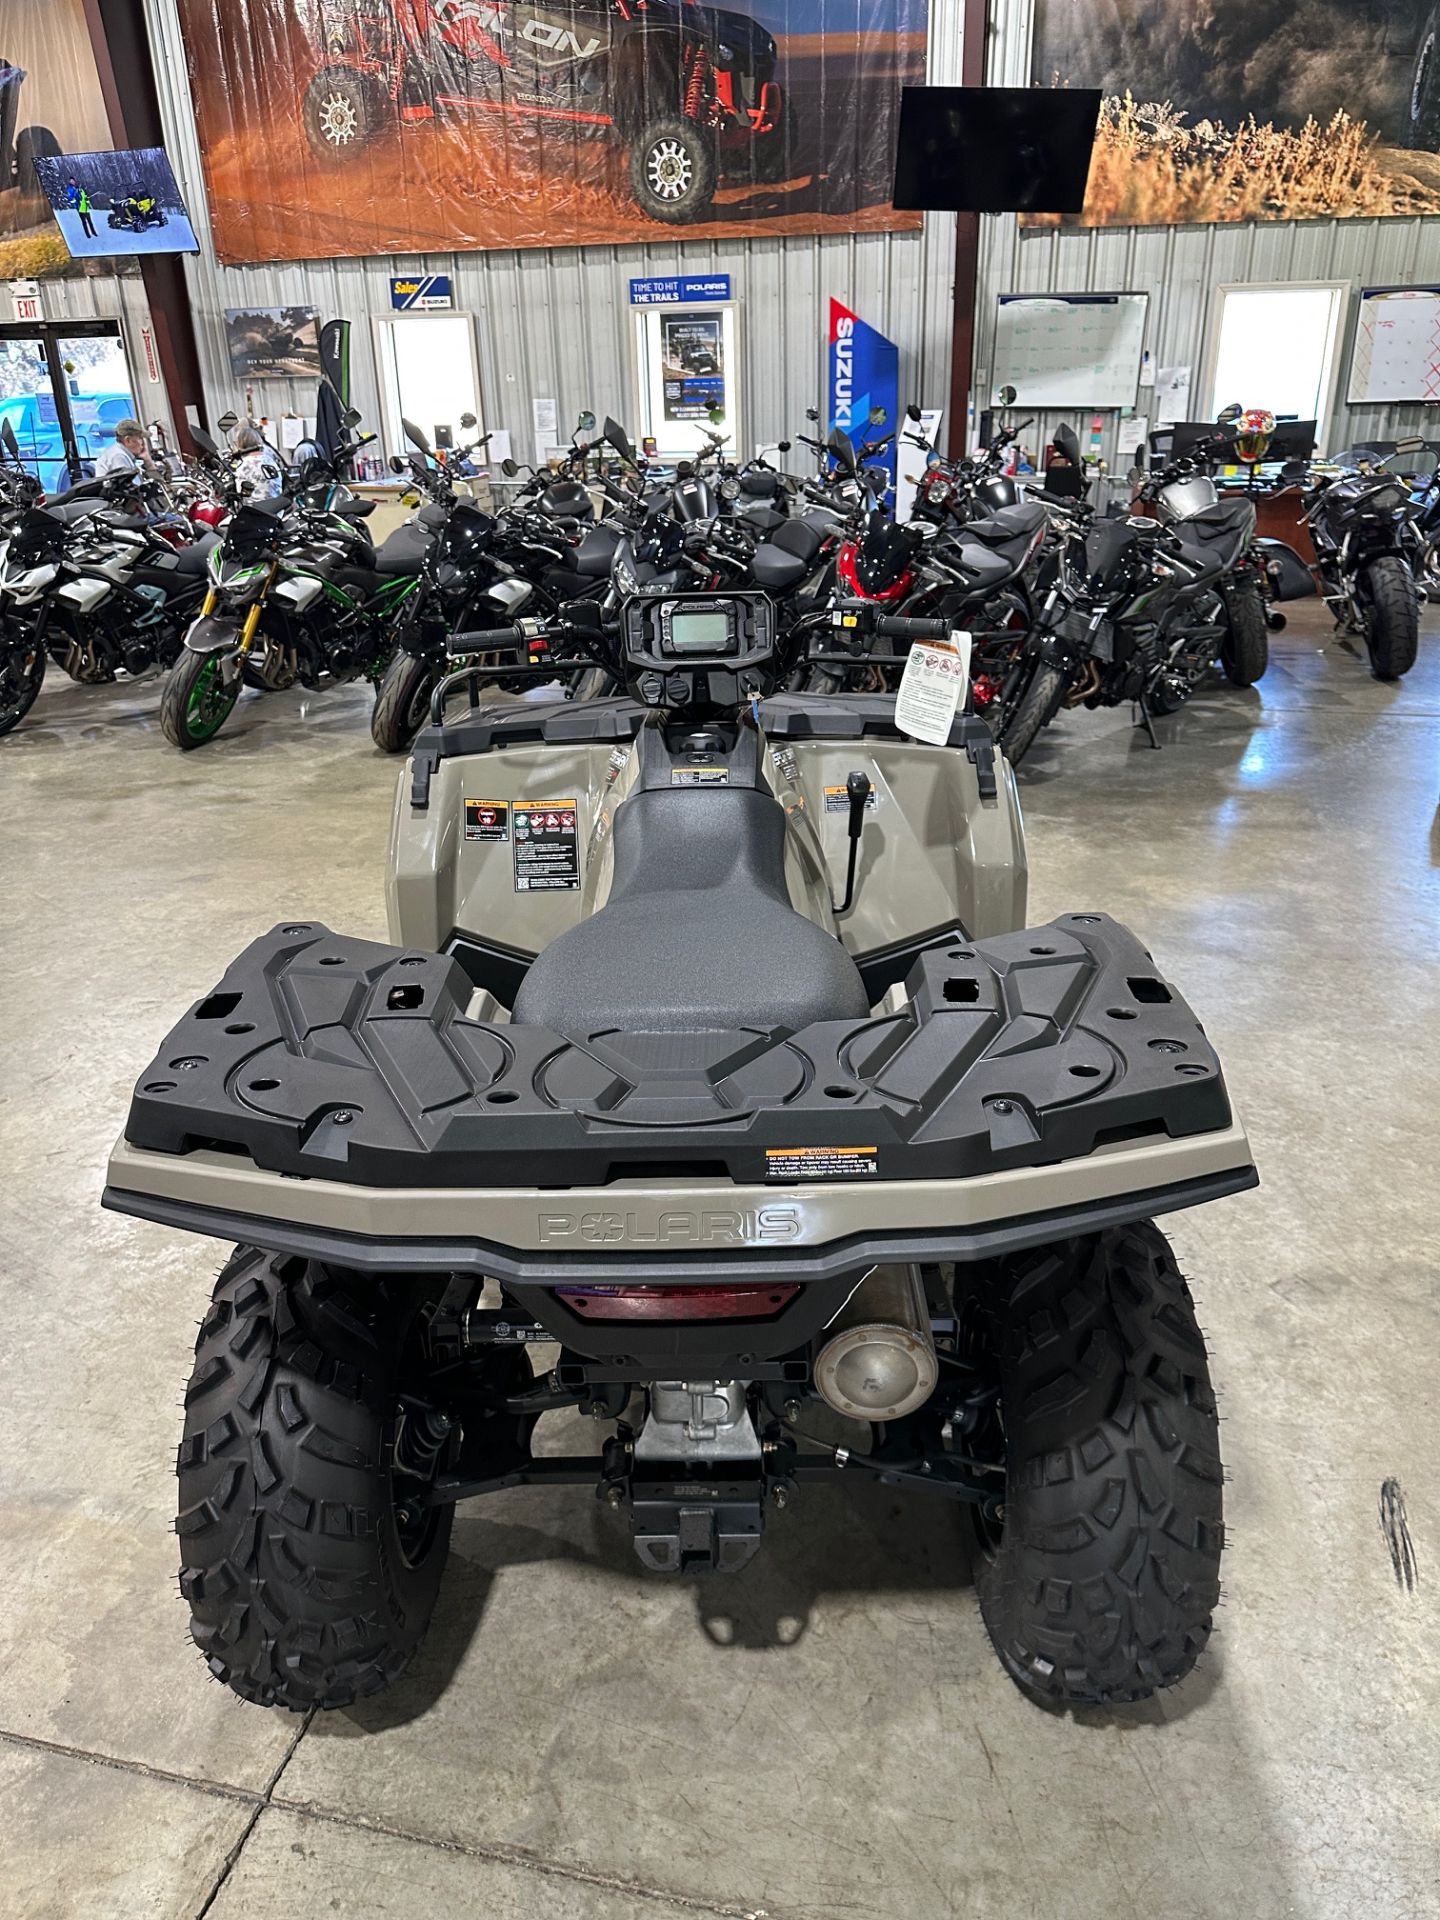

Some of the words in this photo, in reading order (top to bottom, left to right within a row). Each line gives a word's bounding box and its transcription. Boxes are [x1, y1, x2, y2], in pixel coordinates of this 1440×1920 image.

[516, 92, 555, 104] HONDA
[394, 281, 419, 294] Sales
[633, 283, 652, 292] TIME
[653, 283, 664, 291] TO
[665, 282, 679, 290] HIT
[686, 283, 727, 291] POLARIS
[633, 294, 649, 303] THE
[650, 293, 680, 302] TRAILS
[17, 300, 37, 318] EXIT
[835, 317, 854, 427] SUZUKI
[538, 1208, 800, 1243] POLARIS
